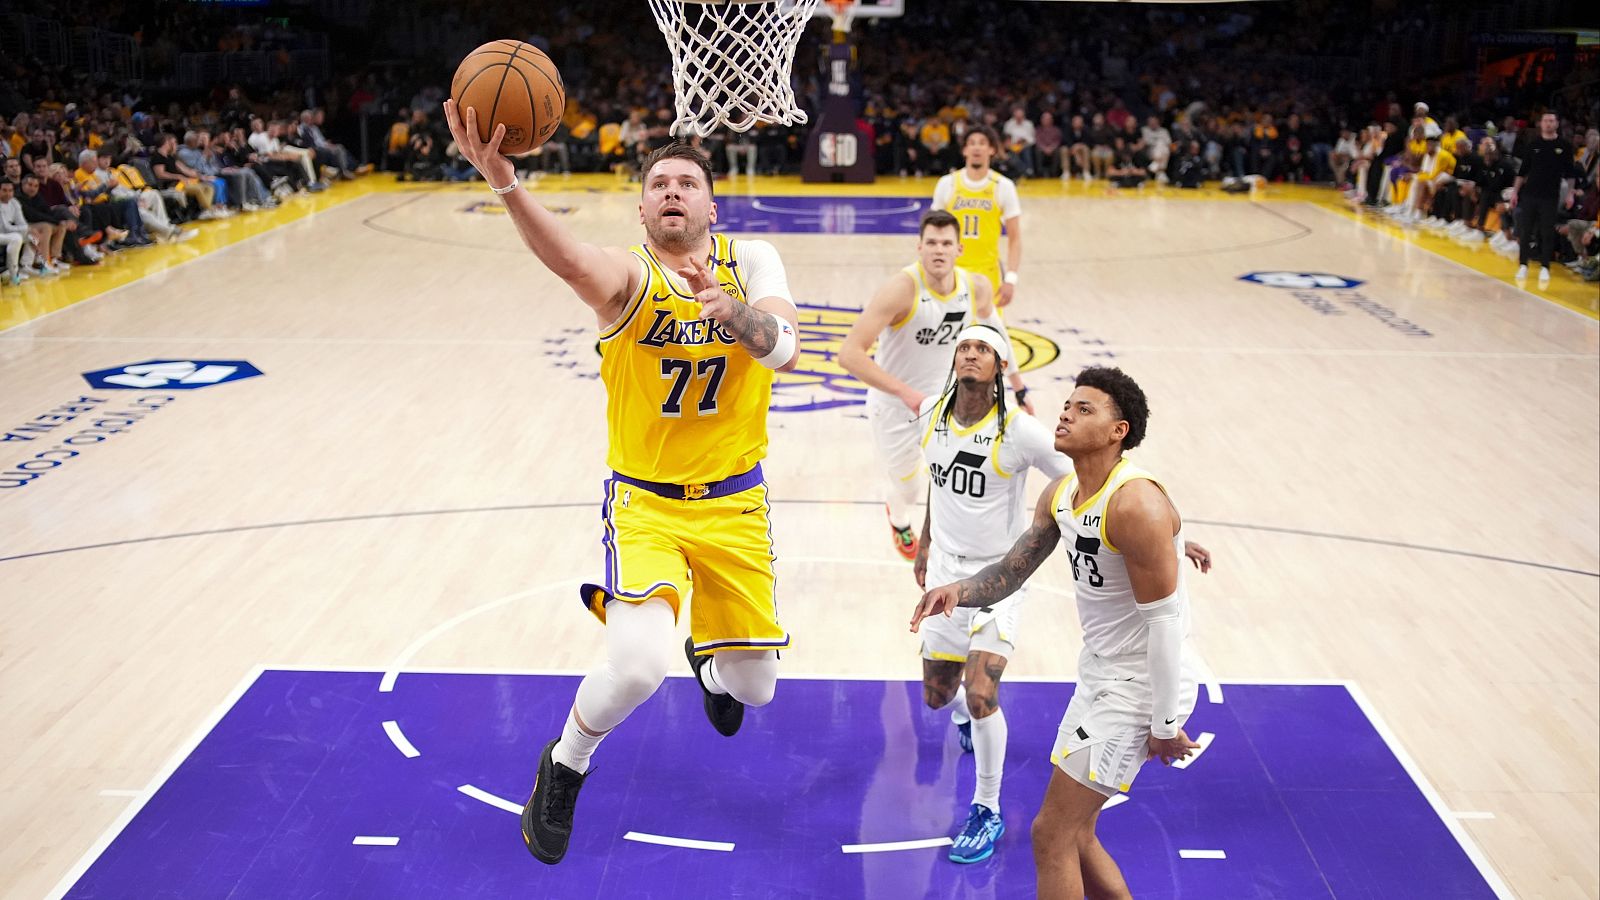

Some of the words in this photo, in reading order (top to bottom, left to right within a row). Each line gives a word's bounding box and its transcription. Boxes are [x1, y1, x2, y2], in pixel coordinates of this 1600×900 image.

[963, 214, 979, 239] 11
[637, 309, 737, 348] LAKER
[659, 355, 728, 418] 77
[973, 434, 993, 447] LVT
[952, 466, 986, 498] 00
[1083, 515, 1101, 528] LVT
[1084, 555, 1104, 588] 3
